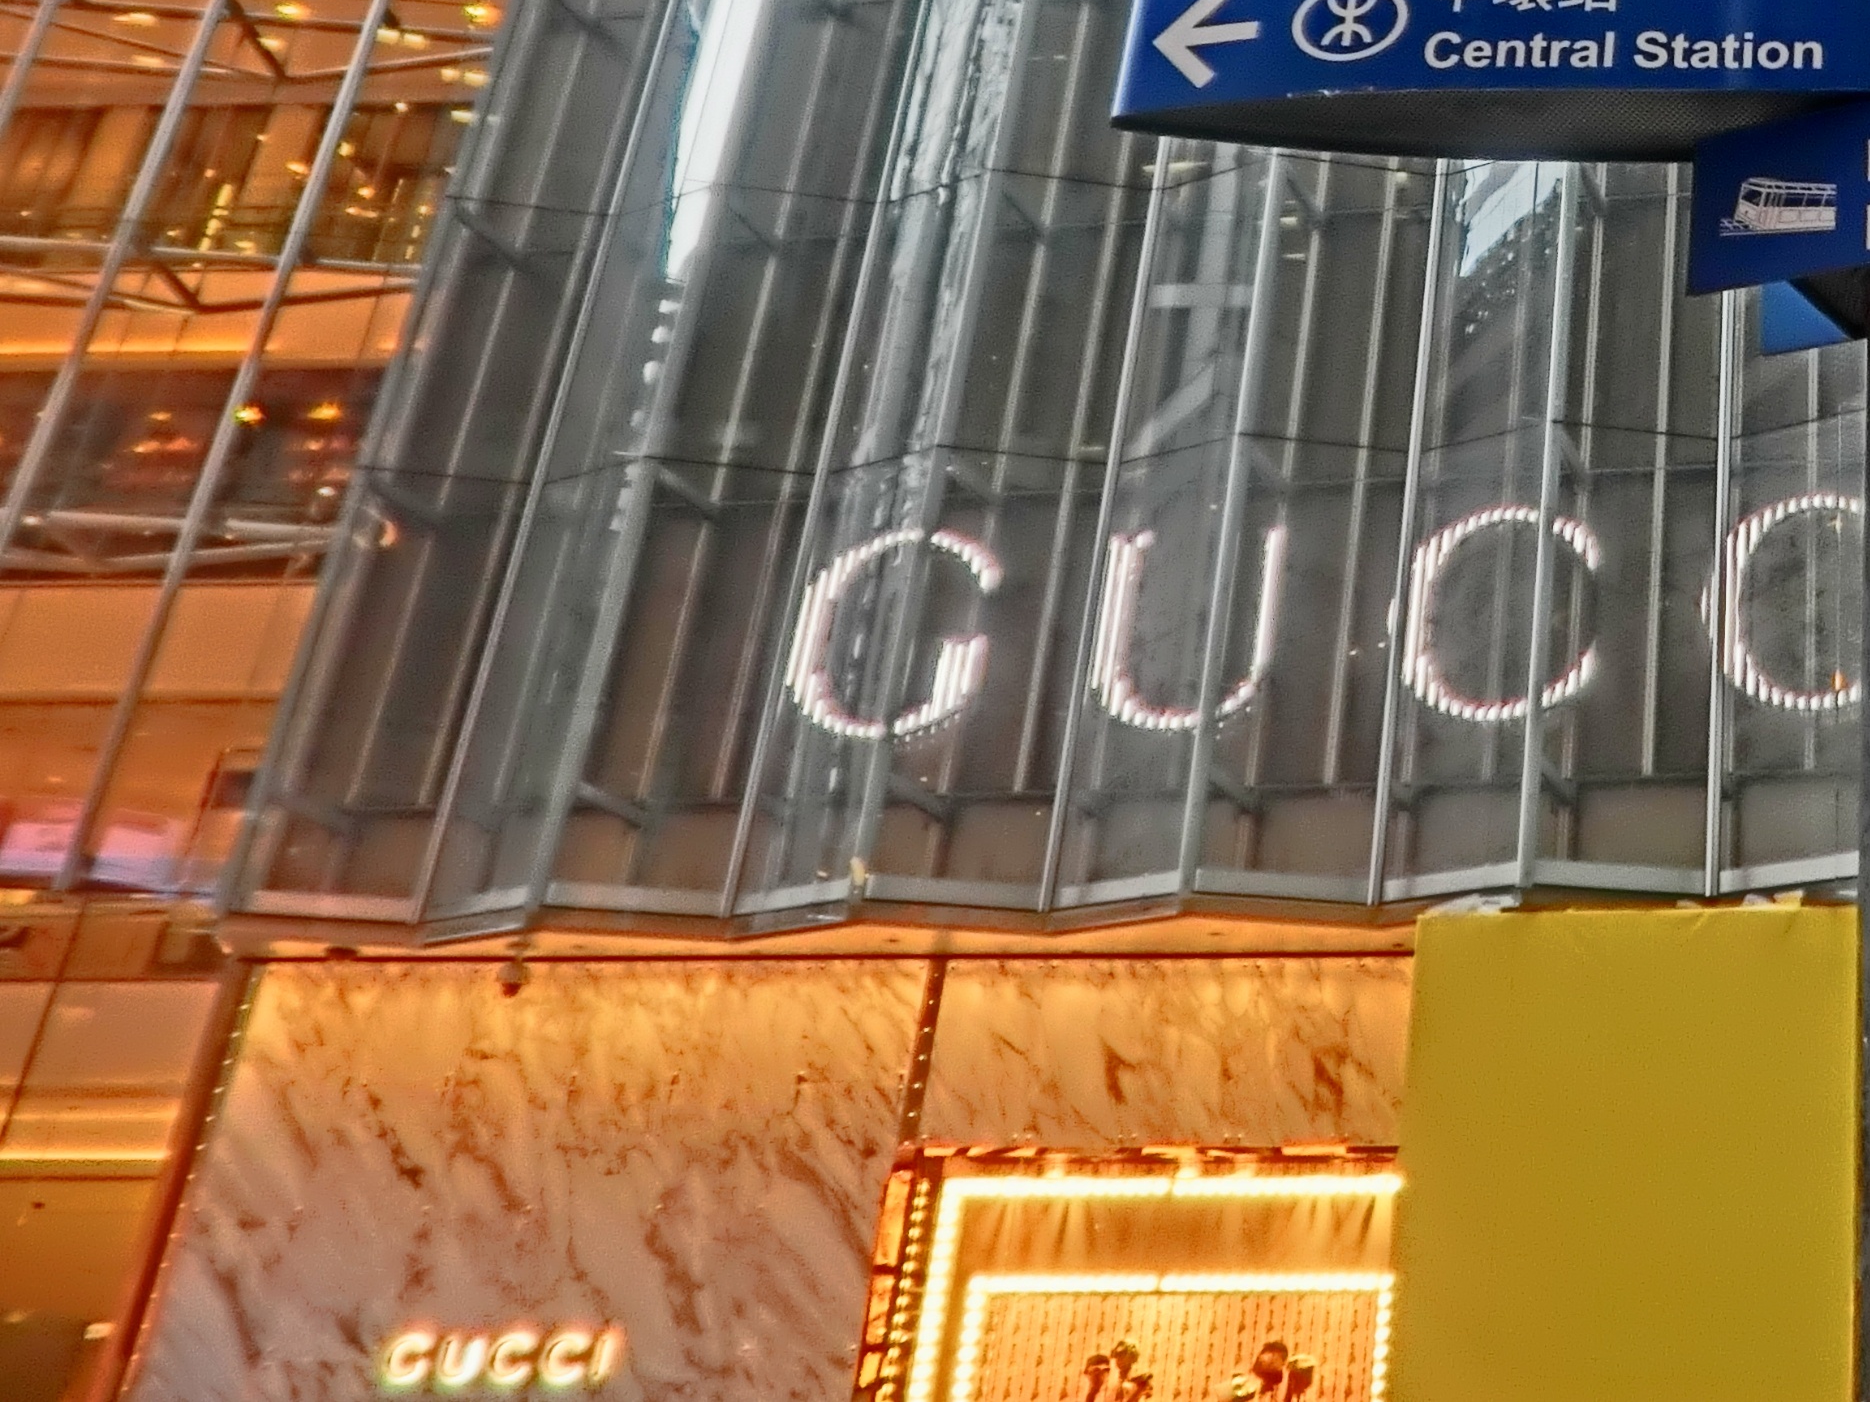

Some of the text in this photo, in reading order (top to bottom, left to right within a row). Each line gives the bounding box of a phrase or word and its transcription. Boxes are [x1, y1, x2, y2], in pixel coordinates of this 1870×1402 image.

[1424, 31, 1823, 69] Central Station
[384, 1326, 622, 1385] GUCCI
